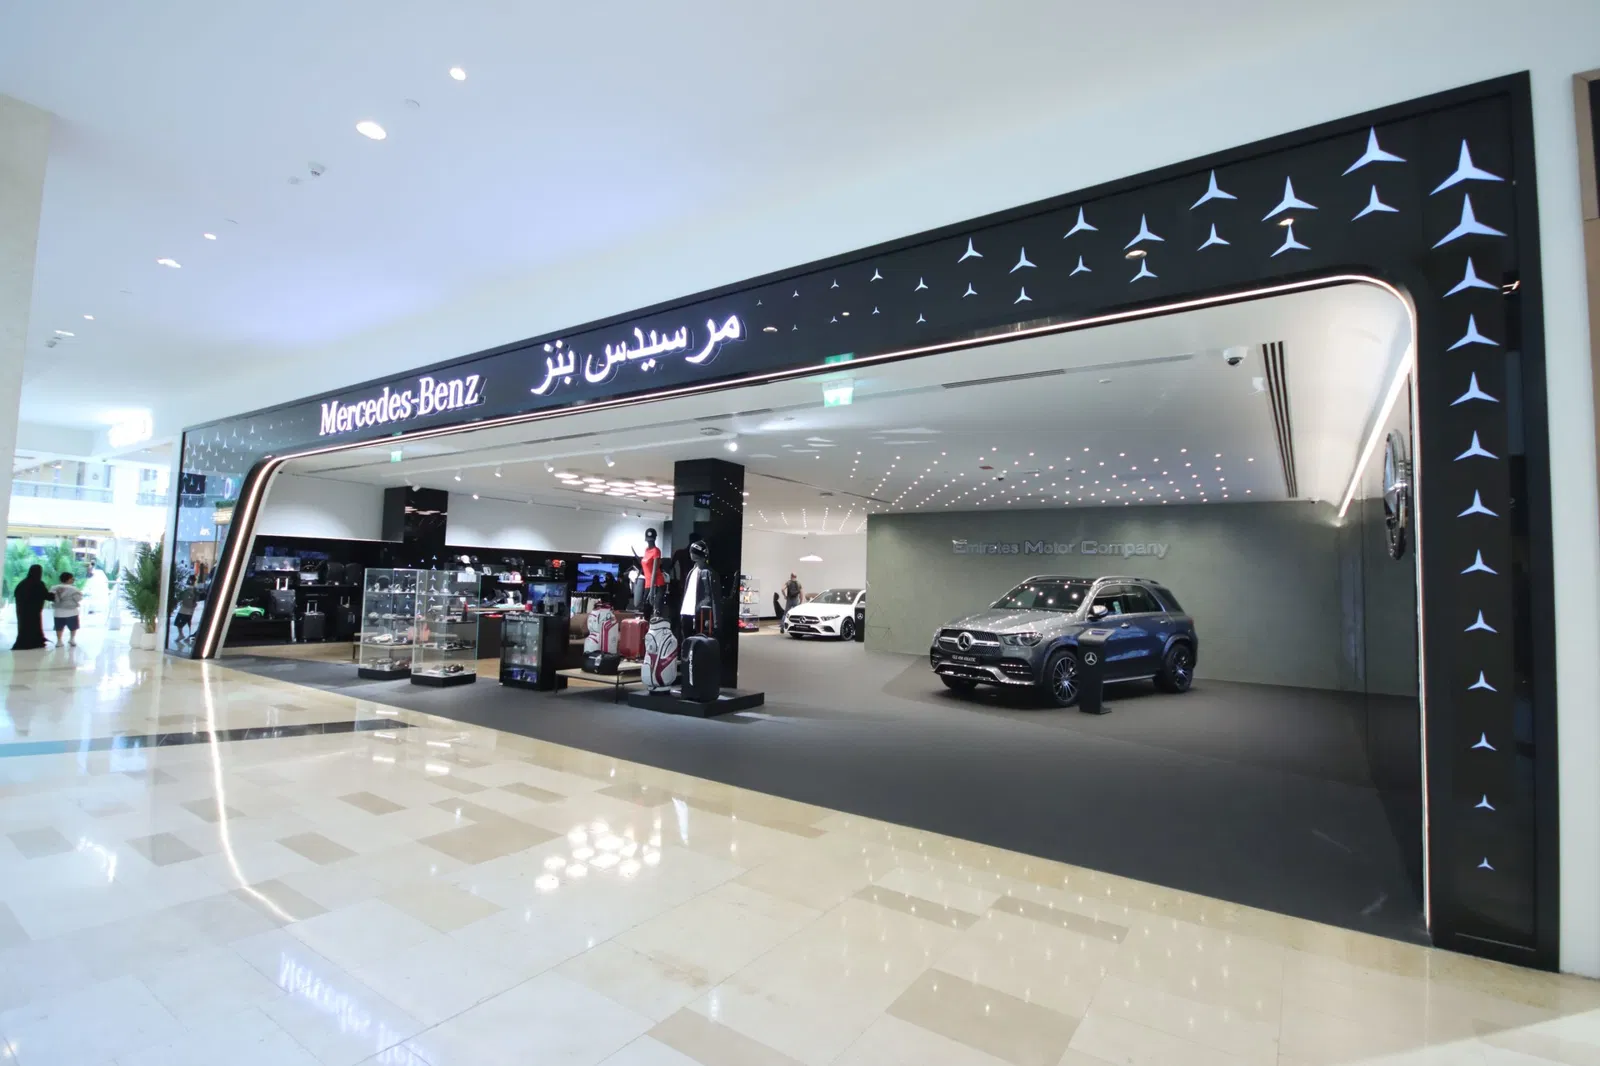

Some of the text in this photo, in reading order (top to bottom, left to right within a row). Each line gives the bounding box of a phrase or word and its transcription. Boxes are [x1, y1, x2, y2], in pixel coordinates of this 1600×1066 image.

[530, 339, 575, 395] بنز
[319, 374, 480, 436] Mercedes-Benz
[952, 539, 1168, 560] Emirates Motor Company
